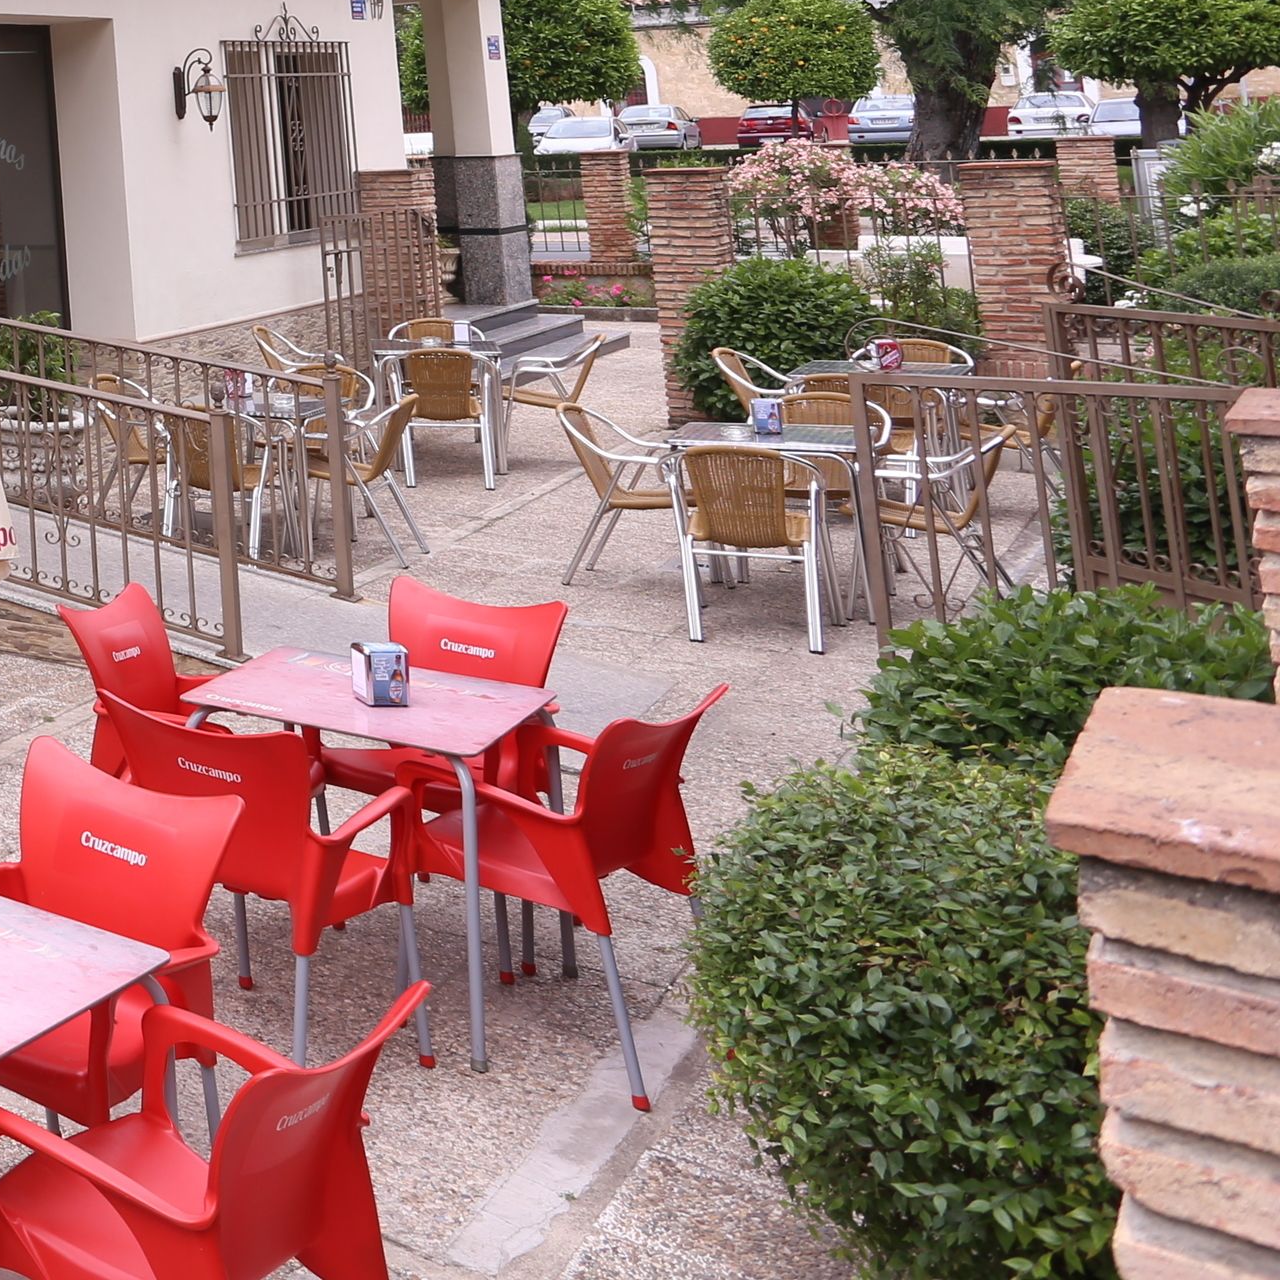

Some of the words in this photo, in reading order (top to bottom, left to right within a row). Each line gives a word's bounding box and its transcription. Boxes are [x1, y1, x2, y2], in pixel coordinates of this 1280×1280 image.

[440, 638, 495, 659] Cruzcampo
[177, 756, 242, 784] Cruzcampo
[80, 830, 147, 867] Cruzcampo
